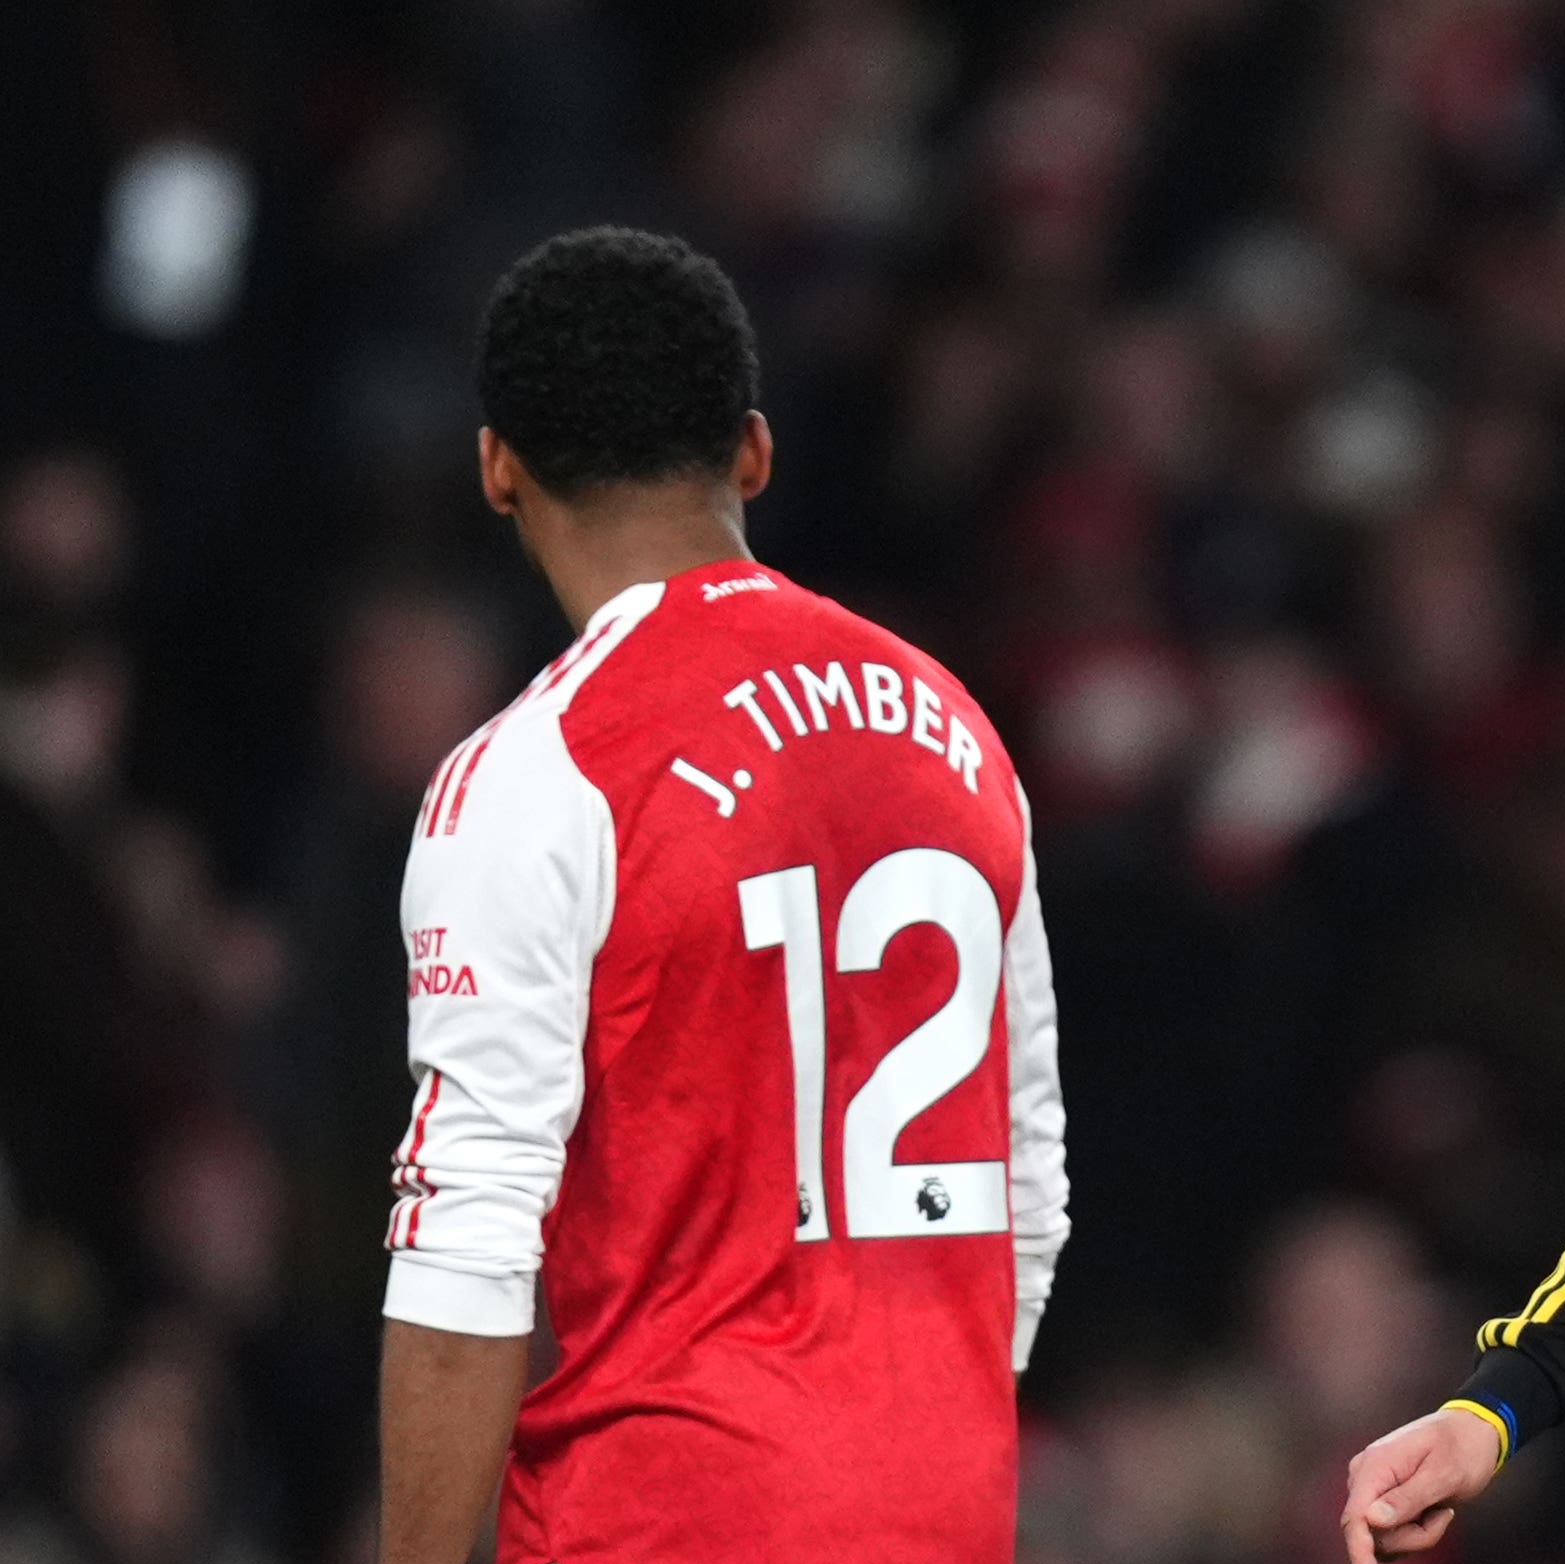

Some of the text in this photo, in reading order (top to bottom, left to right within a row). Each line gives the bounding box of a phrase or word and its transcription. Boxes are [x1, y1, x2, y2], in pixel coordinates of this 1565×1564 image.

[671, 660, 984, 818] J. TIMBER
[737, 847, 1011, 1243] 12
